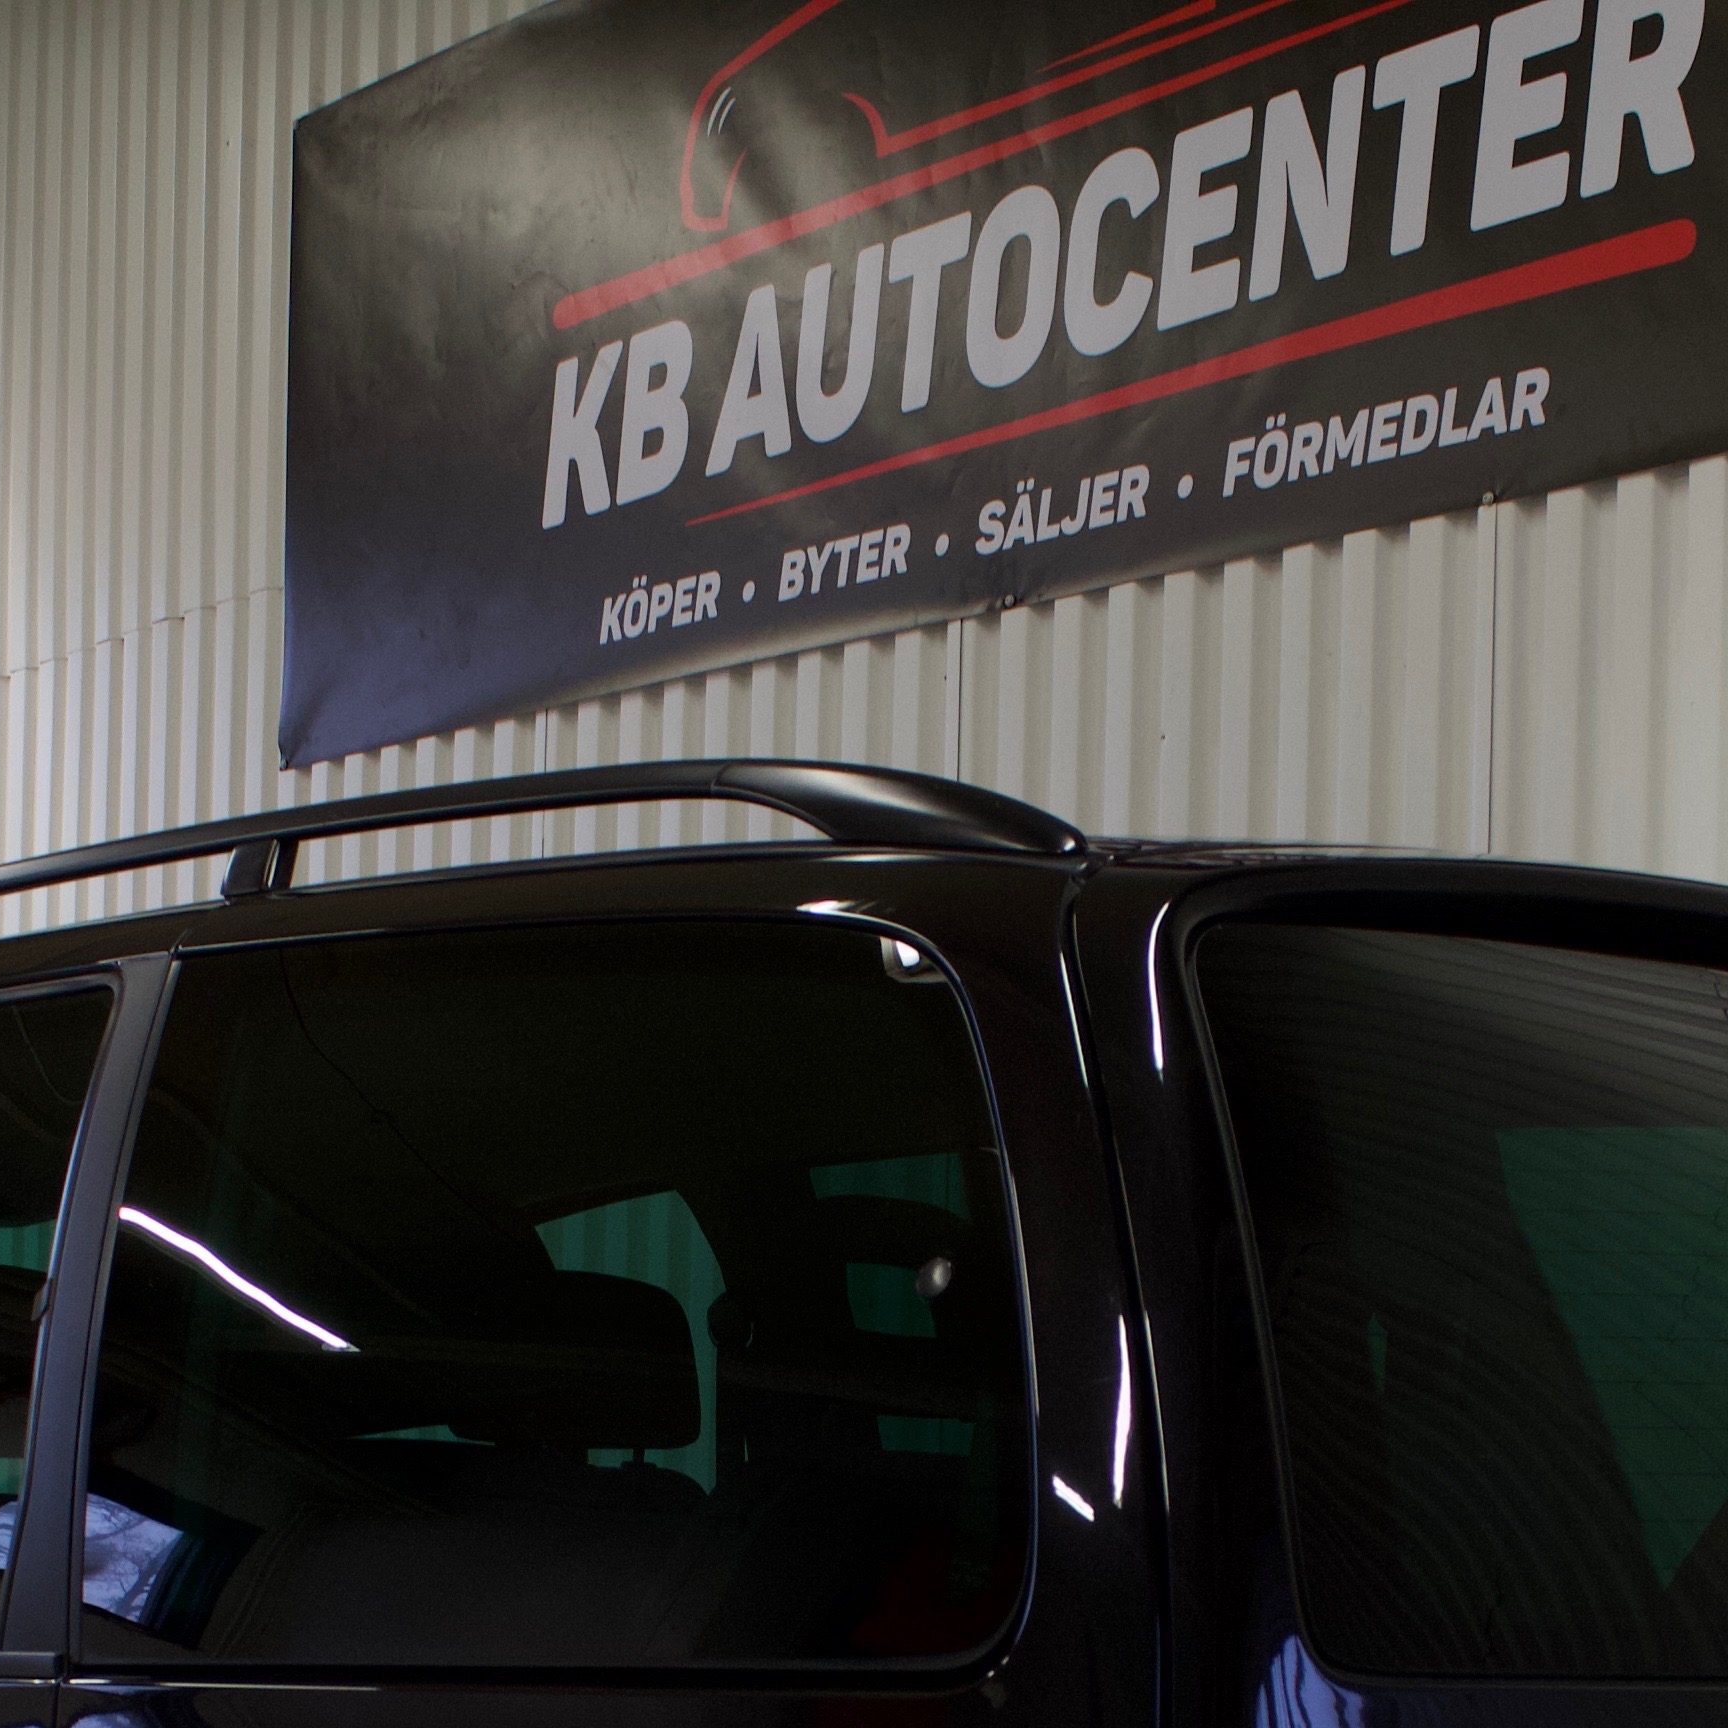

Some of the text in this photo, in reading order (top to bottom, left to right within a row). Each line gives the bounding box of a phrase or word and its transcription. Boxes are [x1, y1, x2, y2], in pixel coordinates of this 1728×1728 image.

[542, 0, 1705, 530] KB AUTOCENTER
[599, 367, 1550, 645] KÖPER BYTER SÄLJER FÖRMEDLAR
